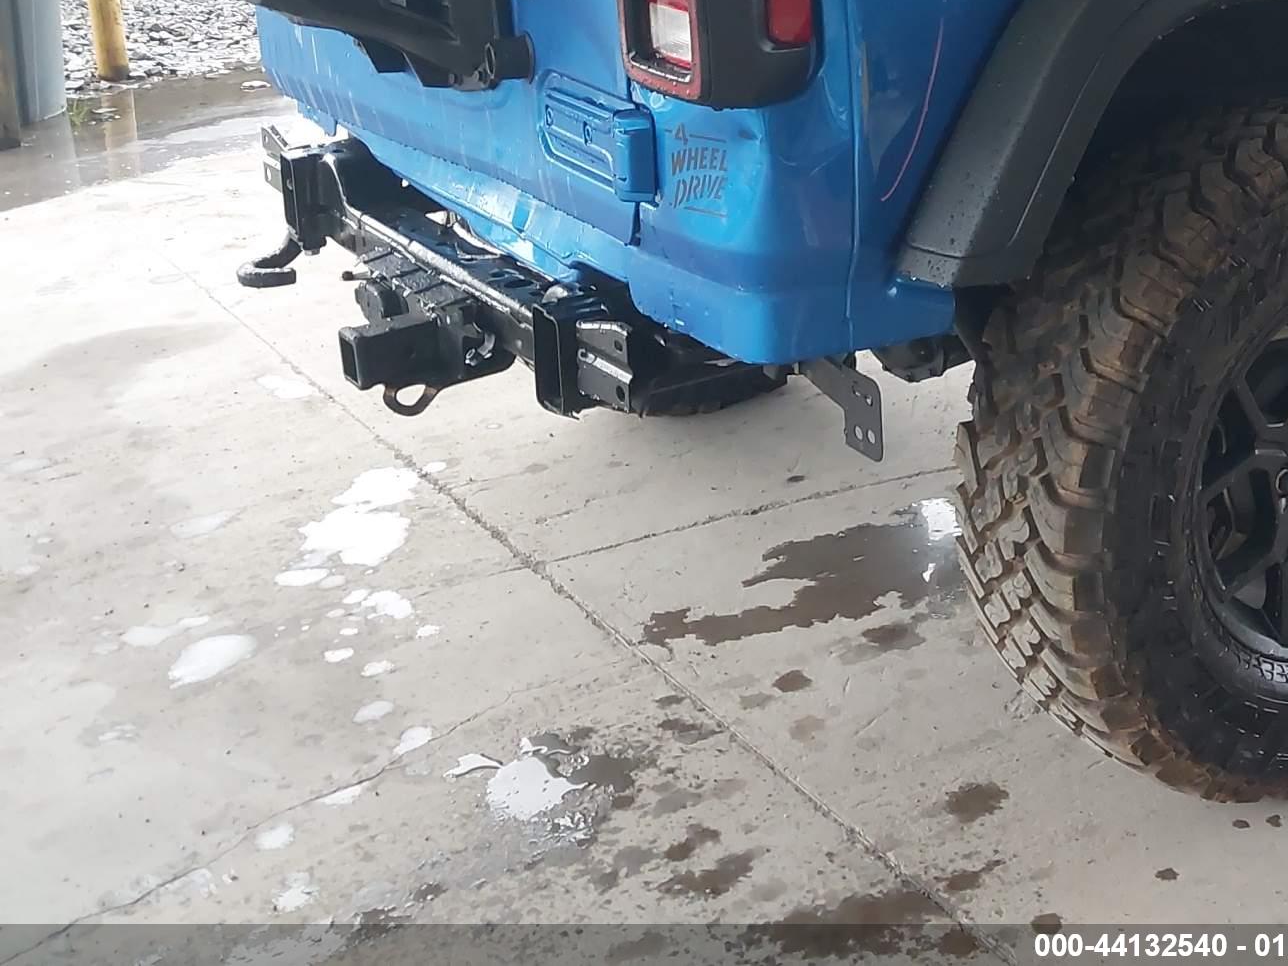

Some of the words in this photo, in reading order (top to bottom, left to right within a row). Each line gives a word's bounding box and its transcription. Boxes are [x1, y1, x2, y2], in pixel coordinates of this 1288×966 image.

[675, 122, 688, 145] 4
[671, 147, 728, 177] WHEEL
[672, 174, 728, 208] DRIVE
